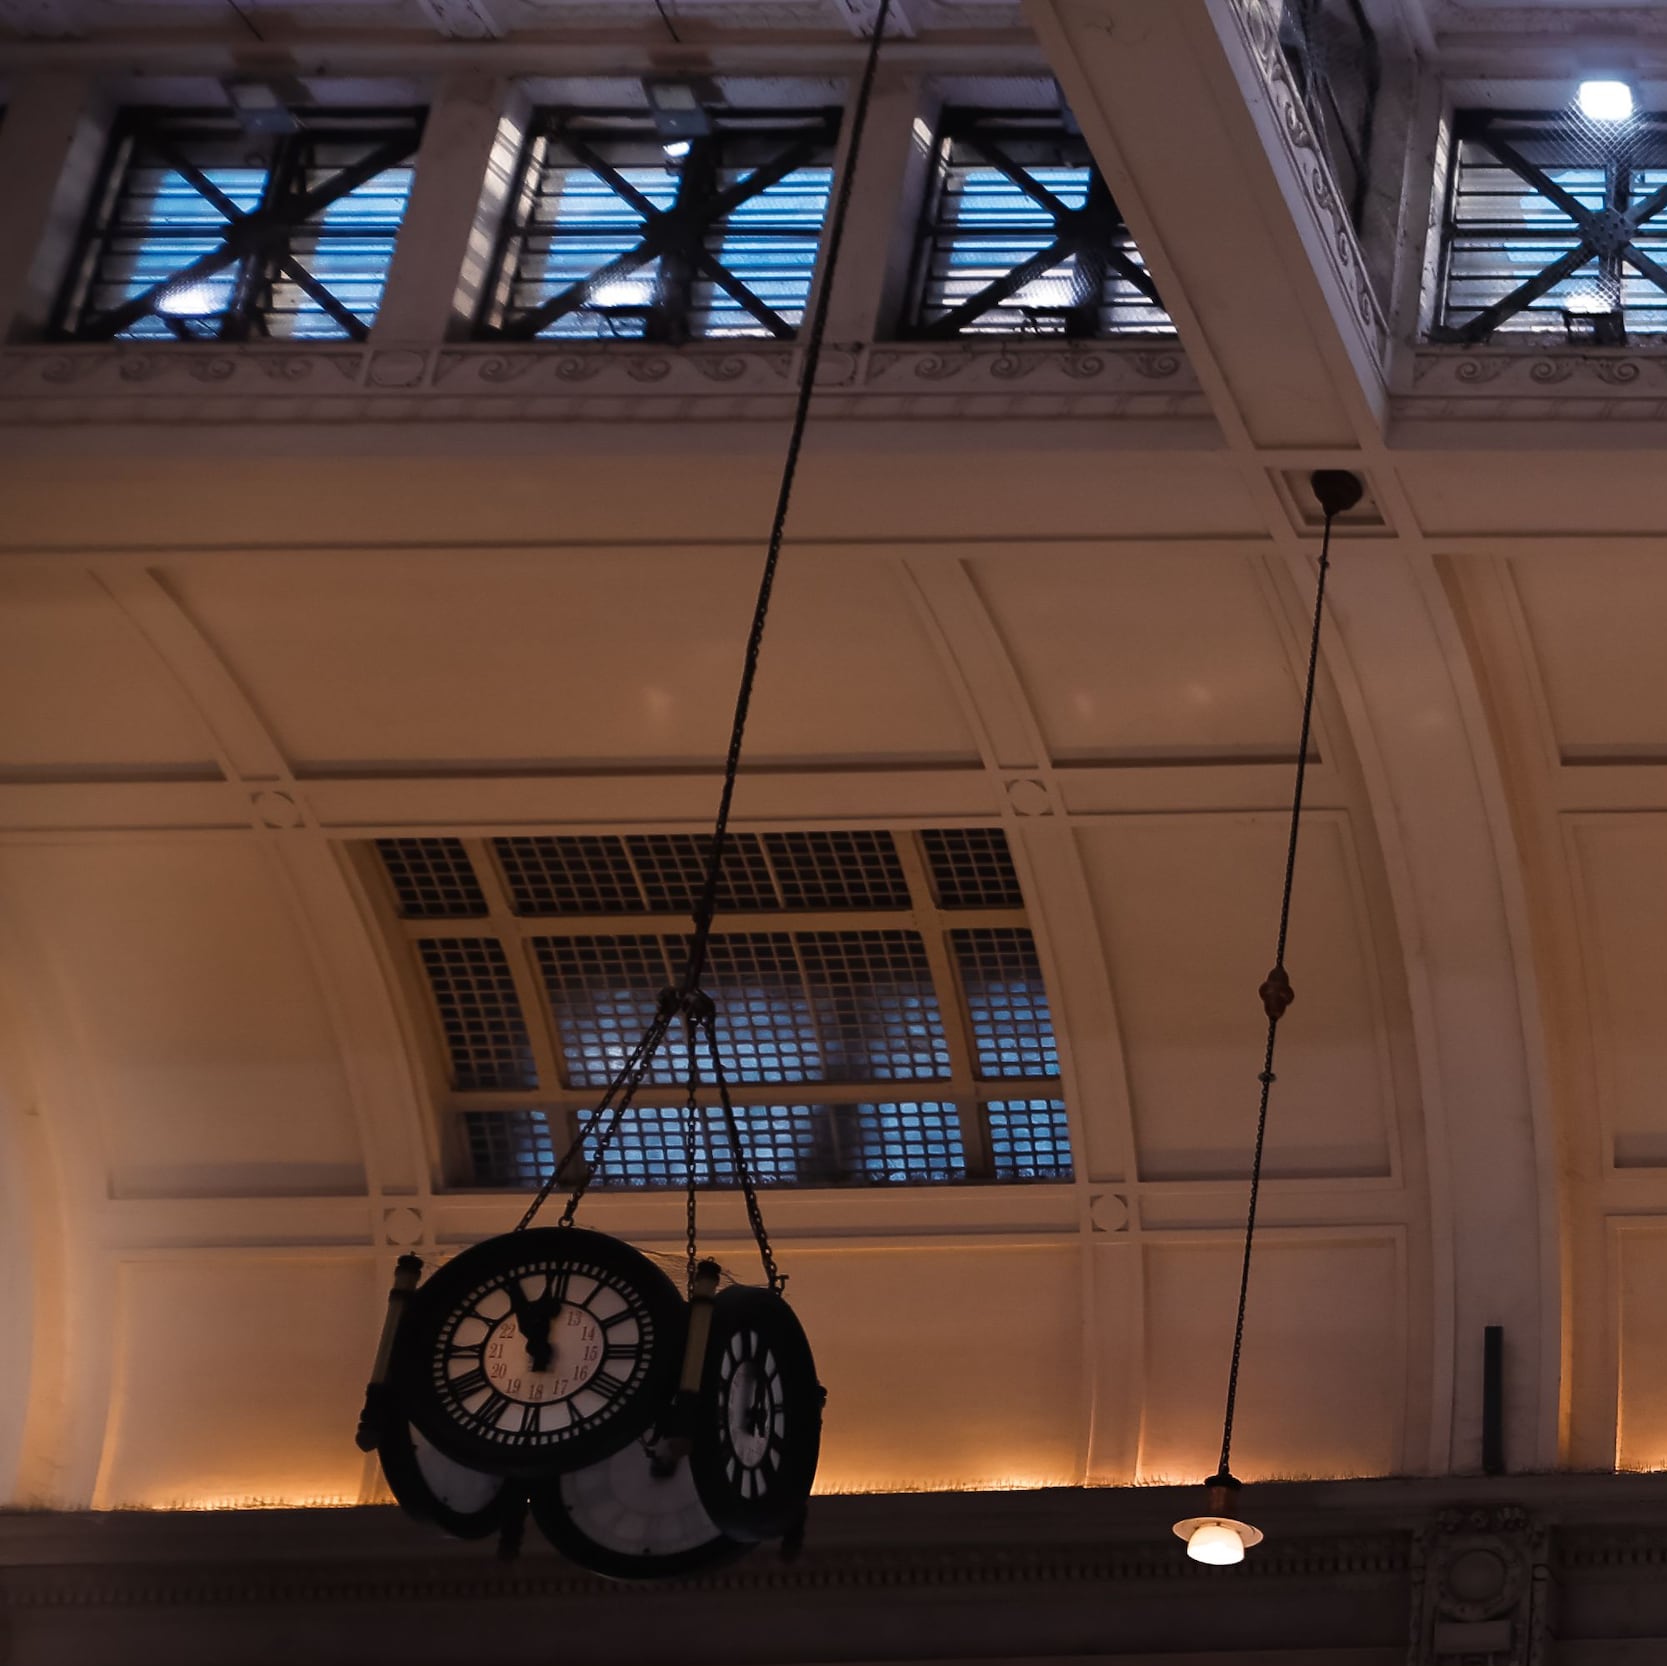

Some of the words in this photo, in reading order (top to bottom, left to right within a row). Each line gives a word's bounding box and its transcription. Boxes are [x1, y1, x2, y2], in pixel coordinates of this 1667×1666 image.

[567, 1311, 583, 1327] 13
[500, 1323, 516, 1340] 22
[581, 1326, 595, 1342] 14
[489, 1343, 504, 1360] 21
[583, 1346, 598, 1362] 15
[490, 1363, 507, 1380] 20
[574, 1365, 589, 1381] 16
[506, 1379, 521, 1395] 19
[528, 1384, 543, 1401] 18
[552, 1379, 569, 1396] 17
